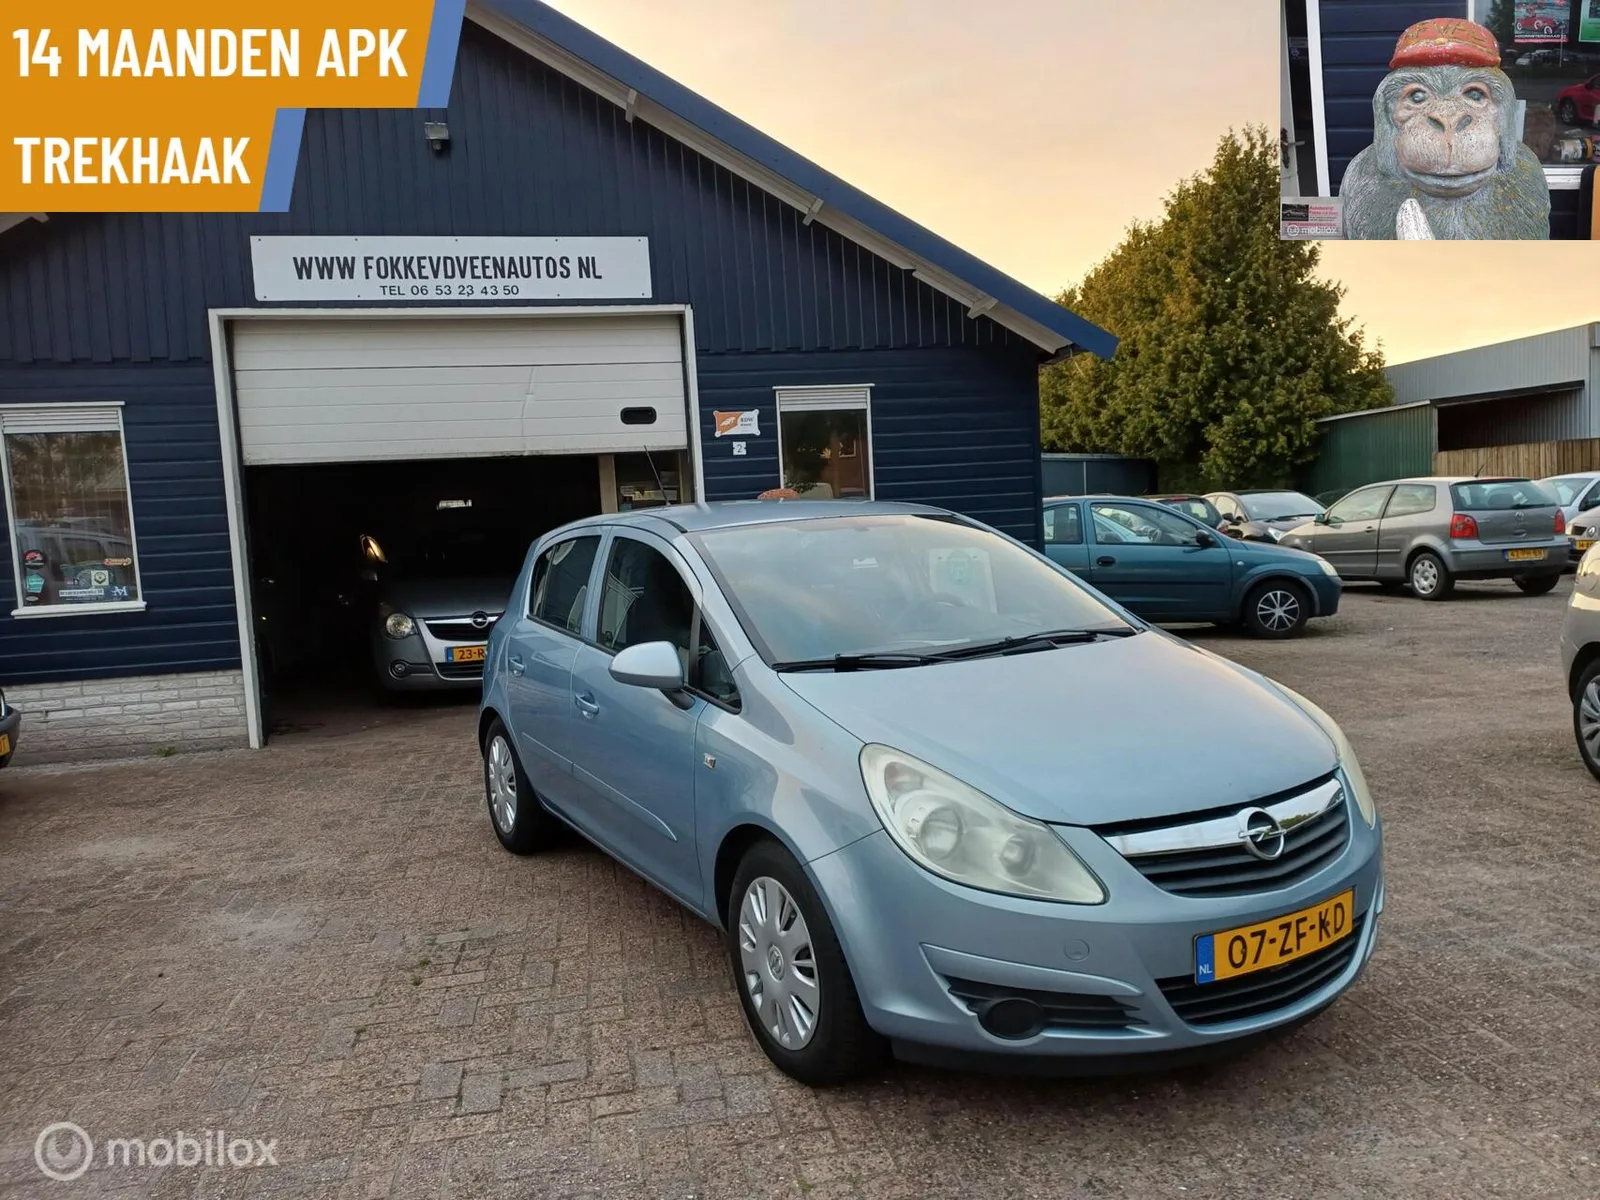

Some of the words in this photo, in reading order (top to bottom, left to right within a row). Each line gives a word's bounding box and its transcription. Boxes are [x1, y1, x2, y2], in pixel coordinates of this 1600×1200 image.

[292, 256, 356, 280] WWW
[363, 255, 571, 280] FOKKEVDVEENAUTOS
[577, 256, 603, 280] NL
[379, 285, 406, 296] TEL
[410, 285, 429, 296] 06
[435, 284, 452, 296] 53
[457, 284, 475, 297] 23
[480, 285, 499, 296] 43
[502, 284, 520, 296] 50
[736, 443, 743, 453] 2
[1227, 901, 1346, 969] 07-ZF-KD
[1198, 964, 1213, 975] NL
